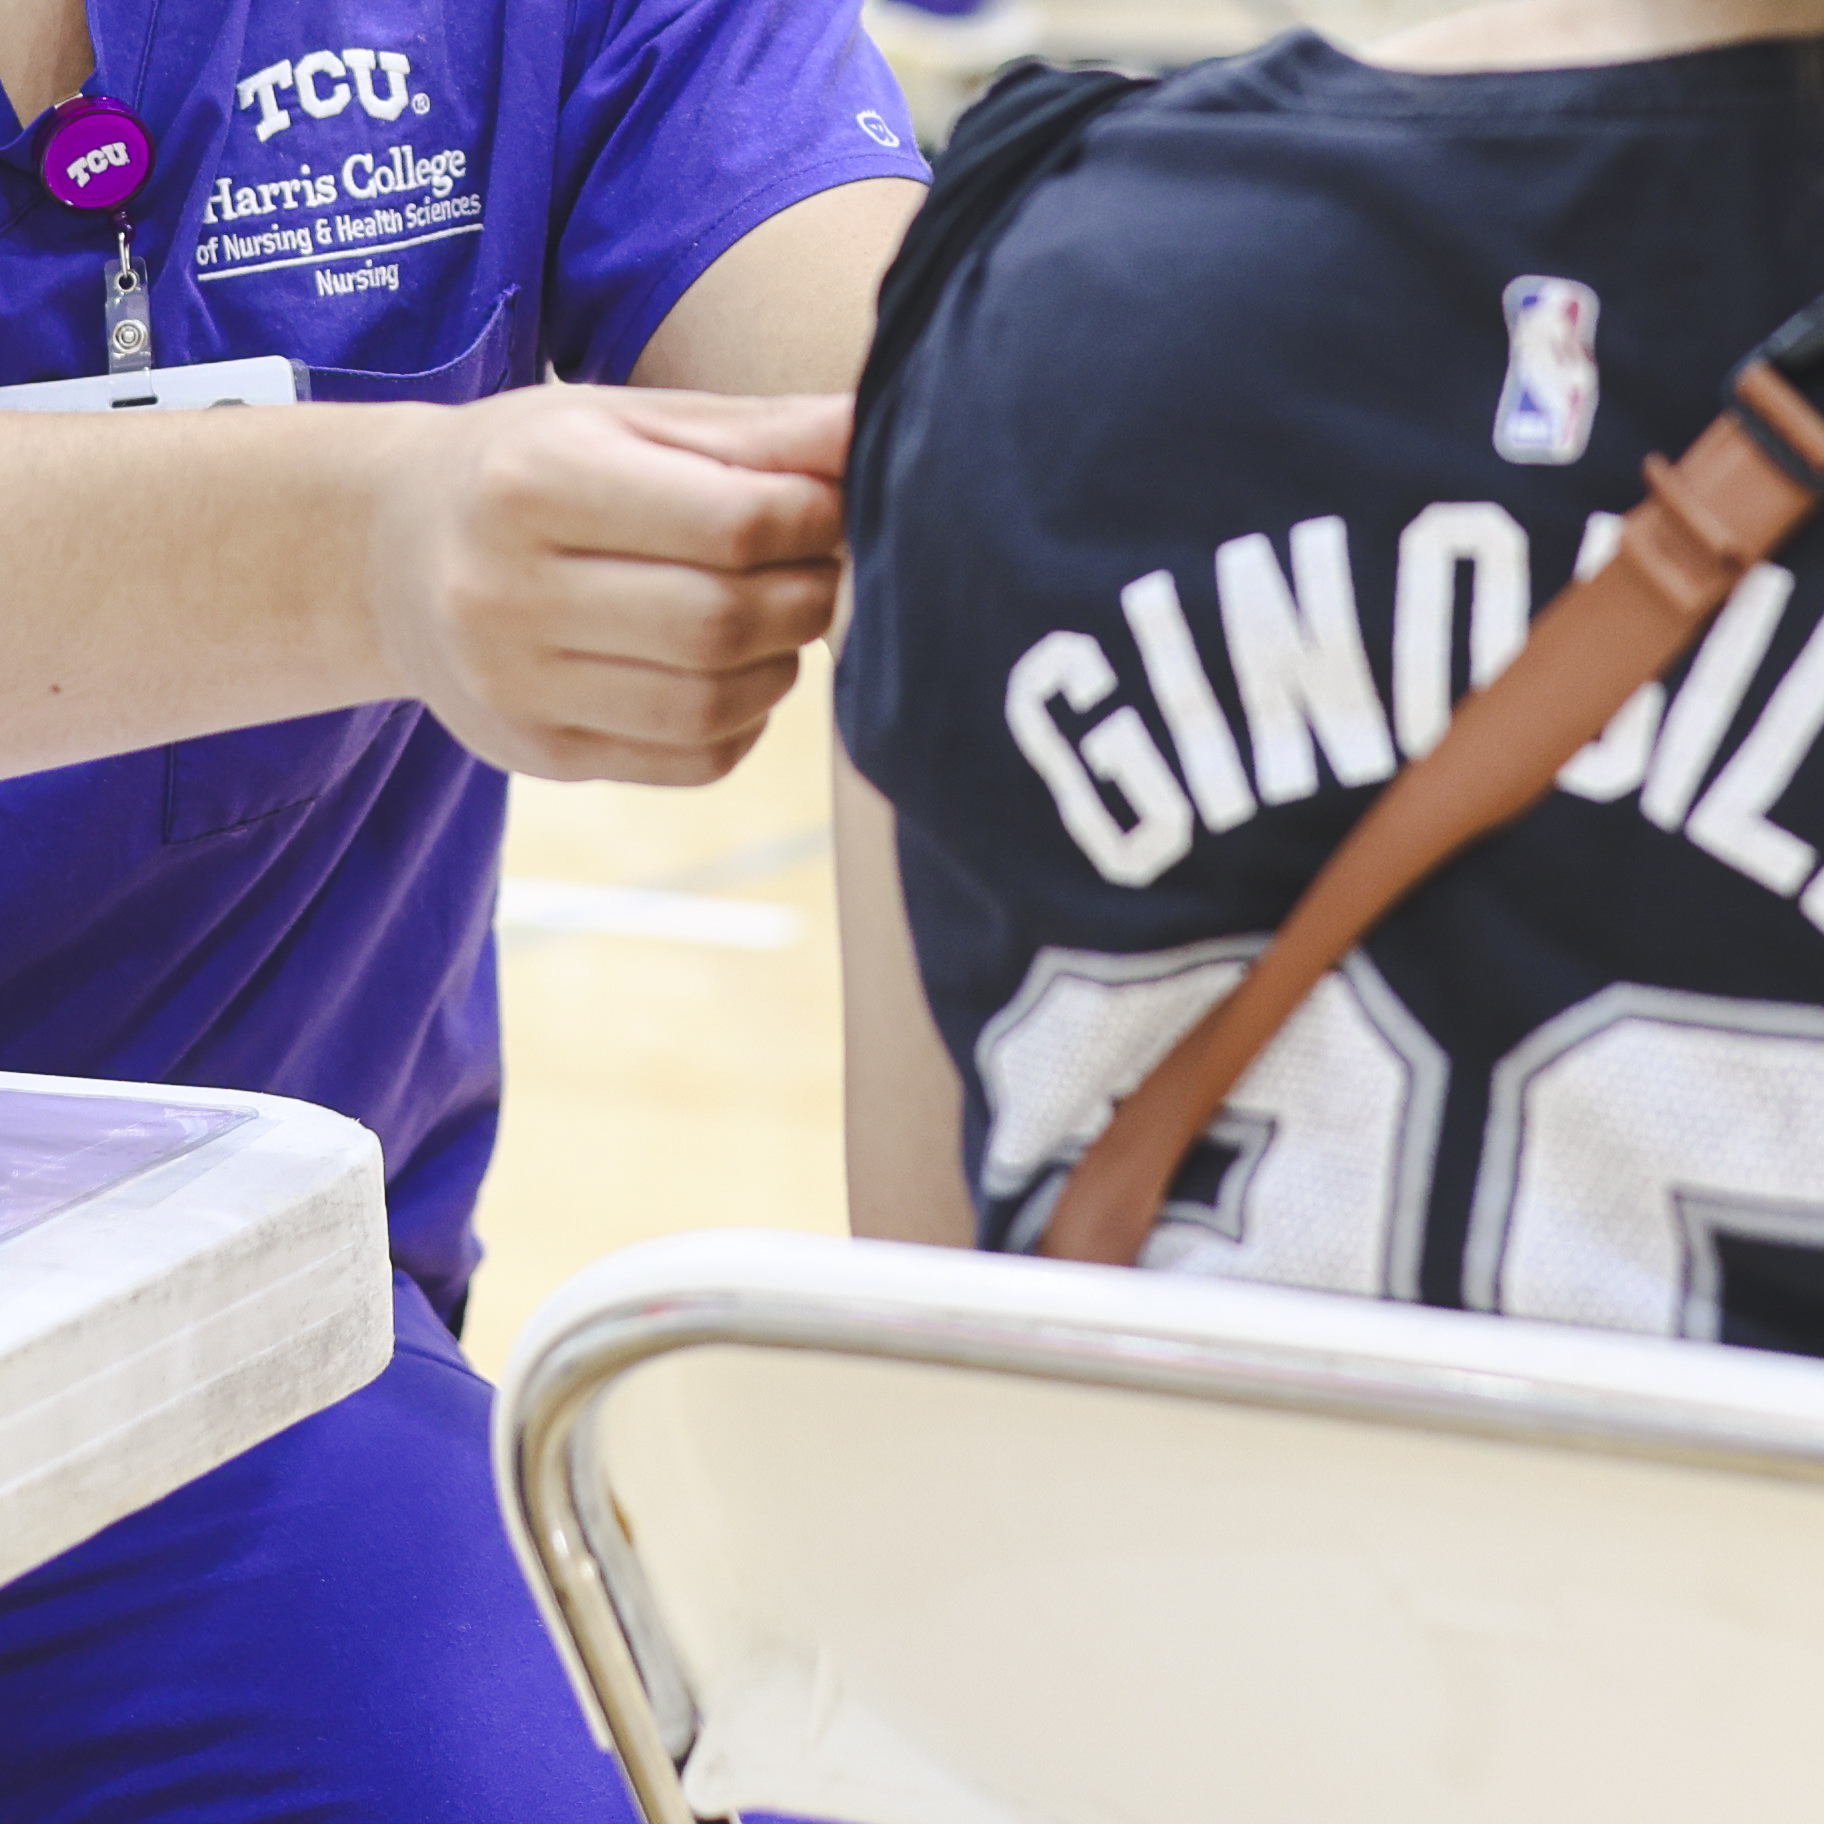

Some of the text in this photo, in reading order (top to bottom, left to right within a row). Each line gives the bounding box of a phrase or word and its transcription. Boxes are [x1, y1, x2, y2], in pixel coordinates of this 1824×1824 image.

[237, 48, 411, 143] TCU
[66, 141, 130, 188] TCU
[202, 144, 467, 224] Harris College
[195, 192, 483, 266] of Nursing & Health Sciences
[315, 259, 401, 297] Nursing
